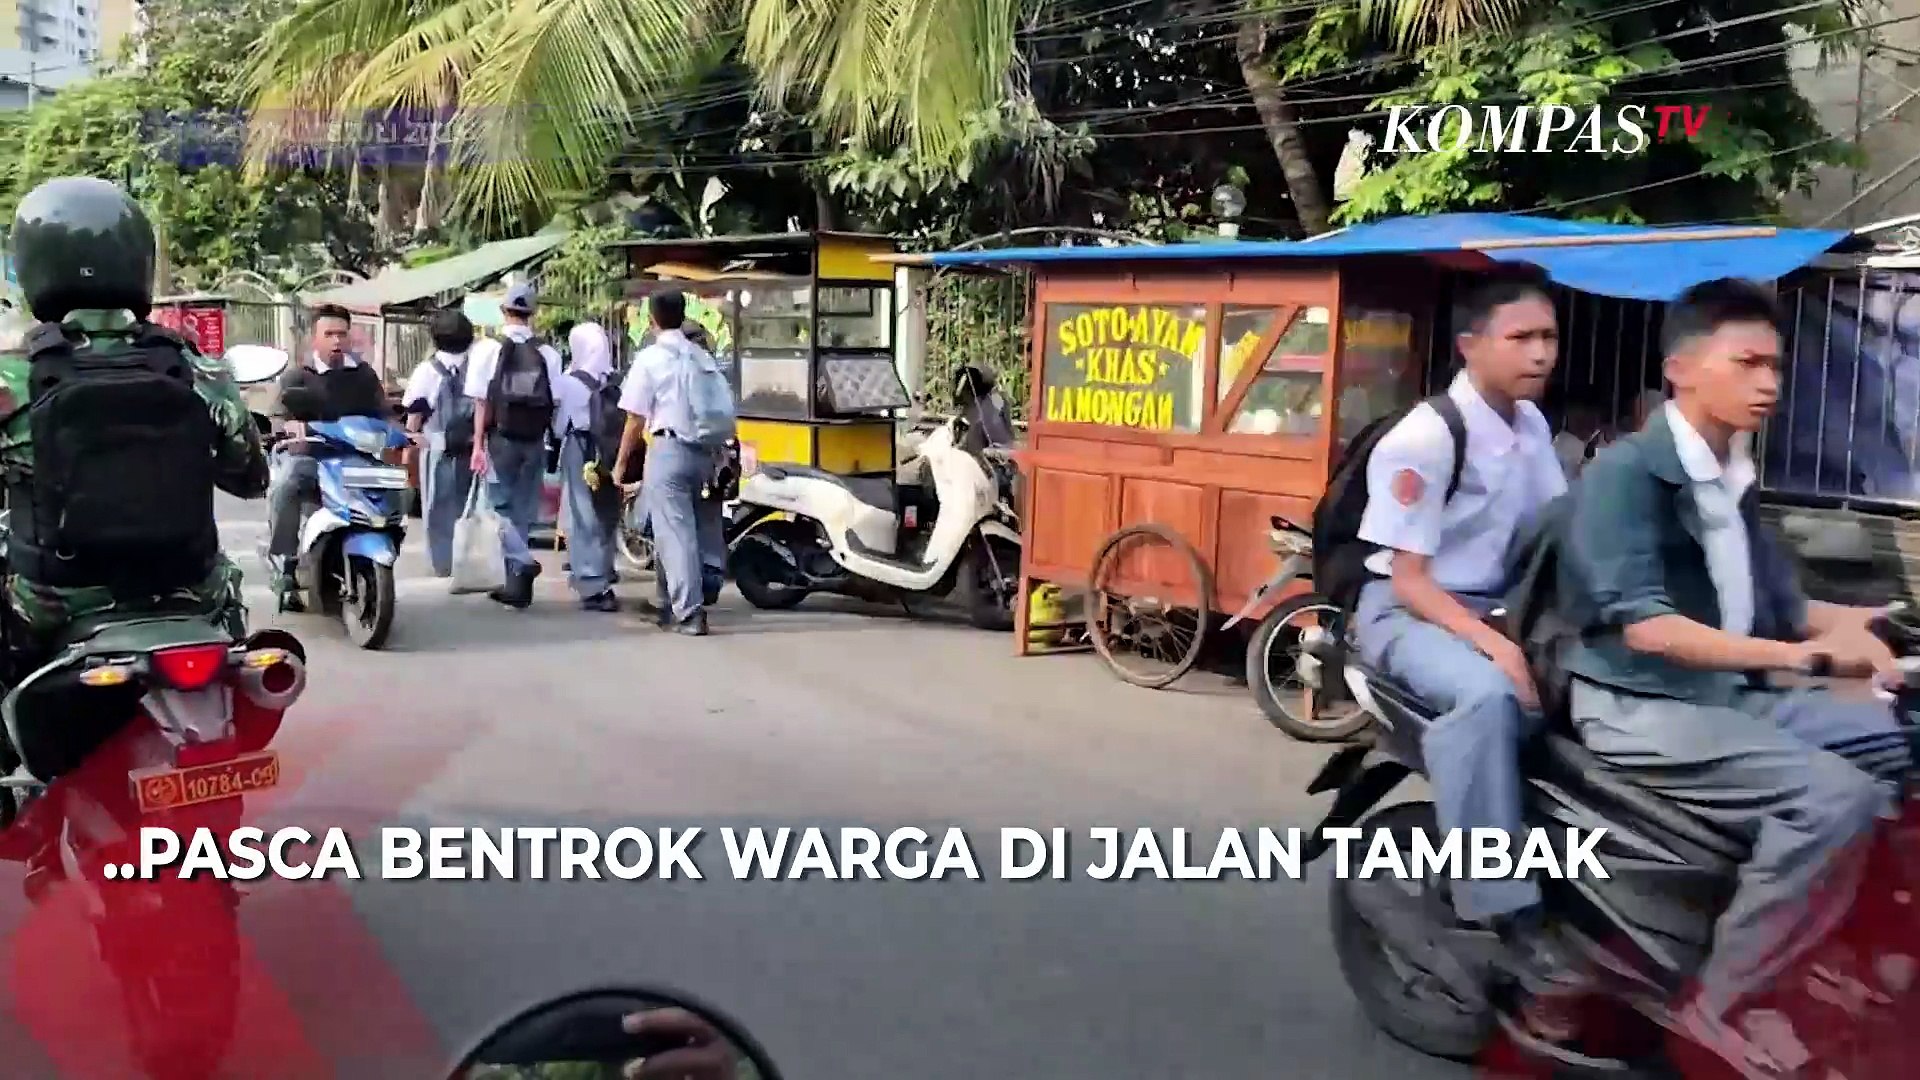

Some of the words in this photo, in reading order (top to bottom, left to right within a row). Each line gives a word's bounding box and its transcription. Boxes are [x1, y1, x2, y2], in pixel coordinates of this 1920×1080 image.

[1059, 306, 1128, 355] SOTO
[1086, 347, 1158, 385] KHAS
[1047, 386, 1174, 430] LAMONGAN
